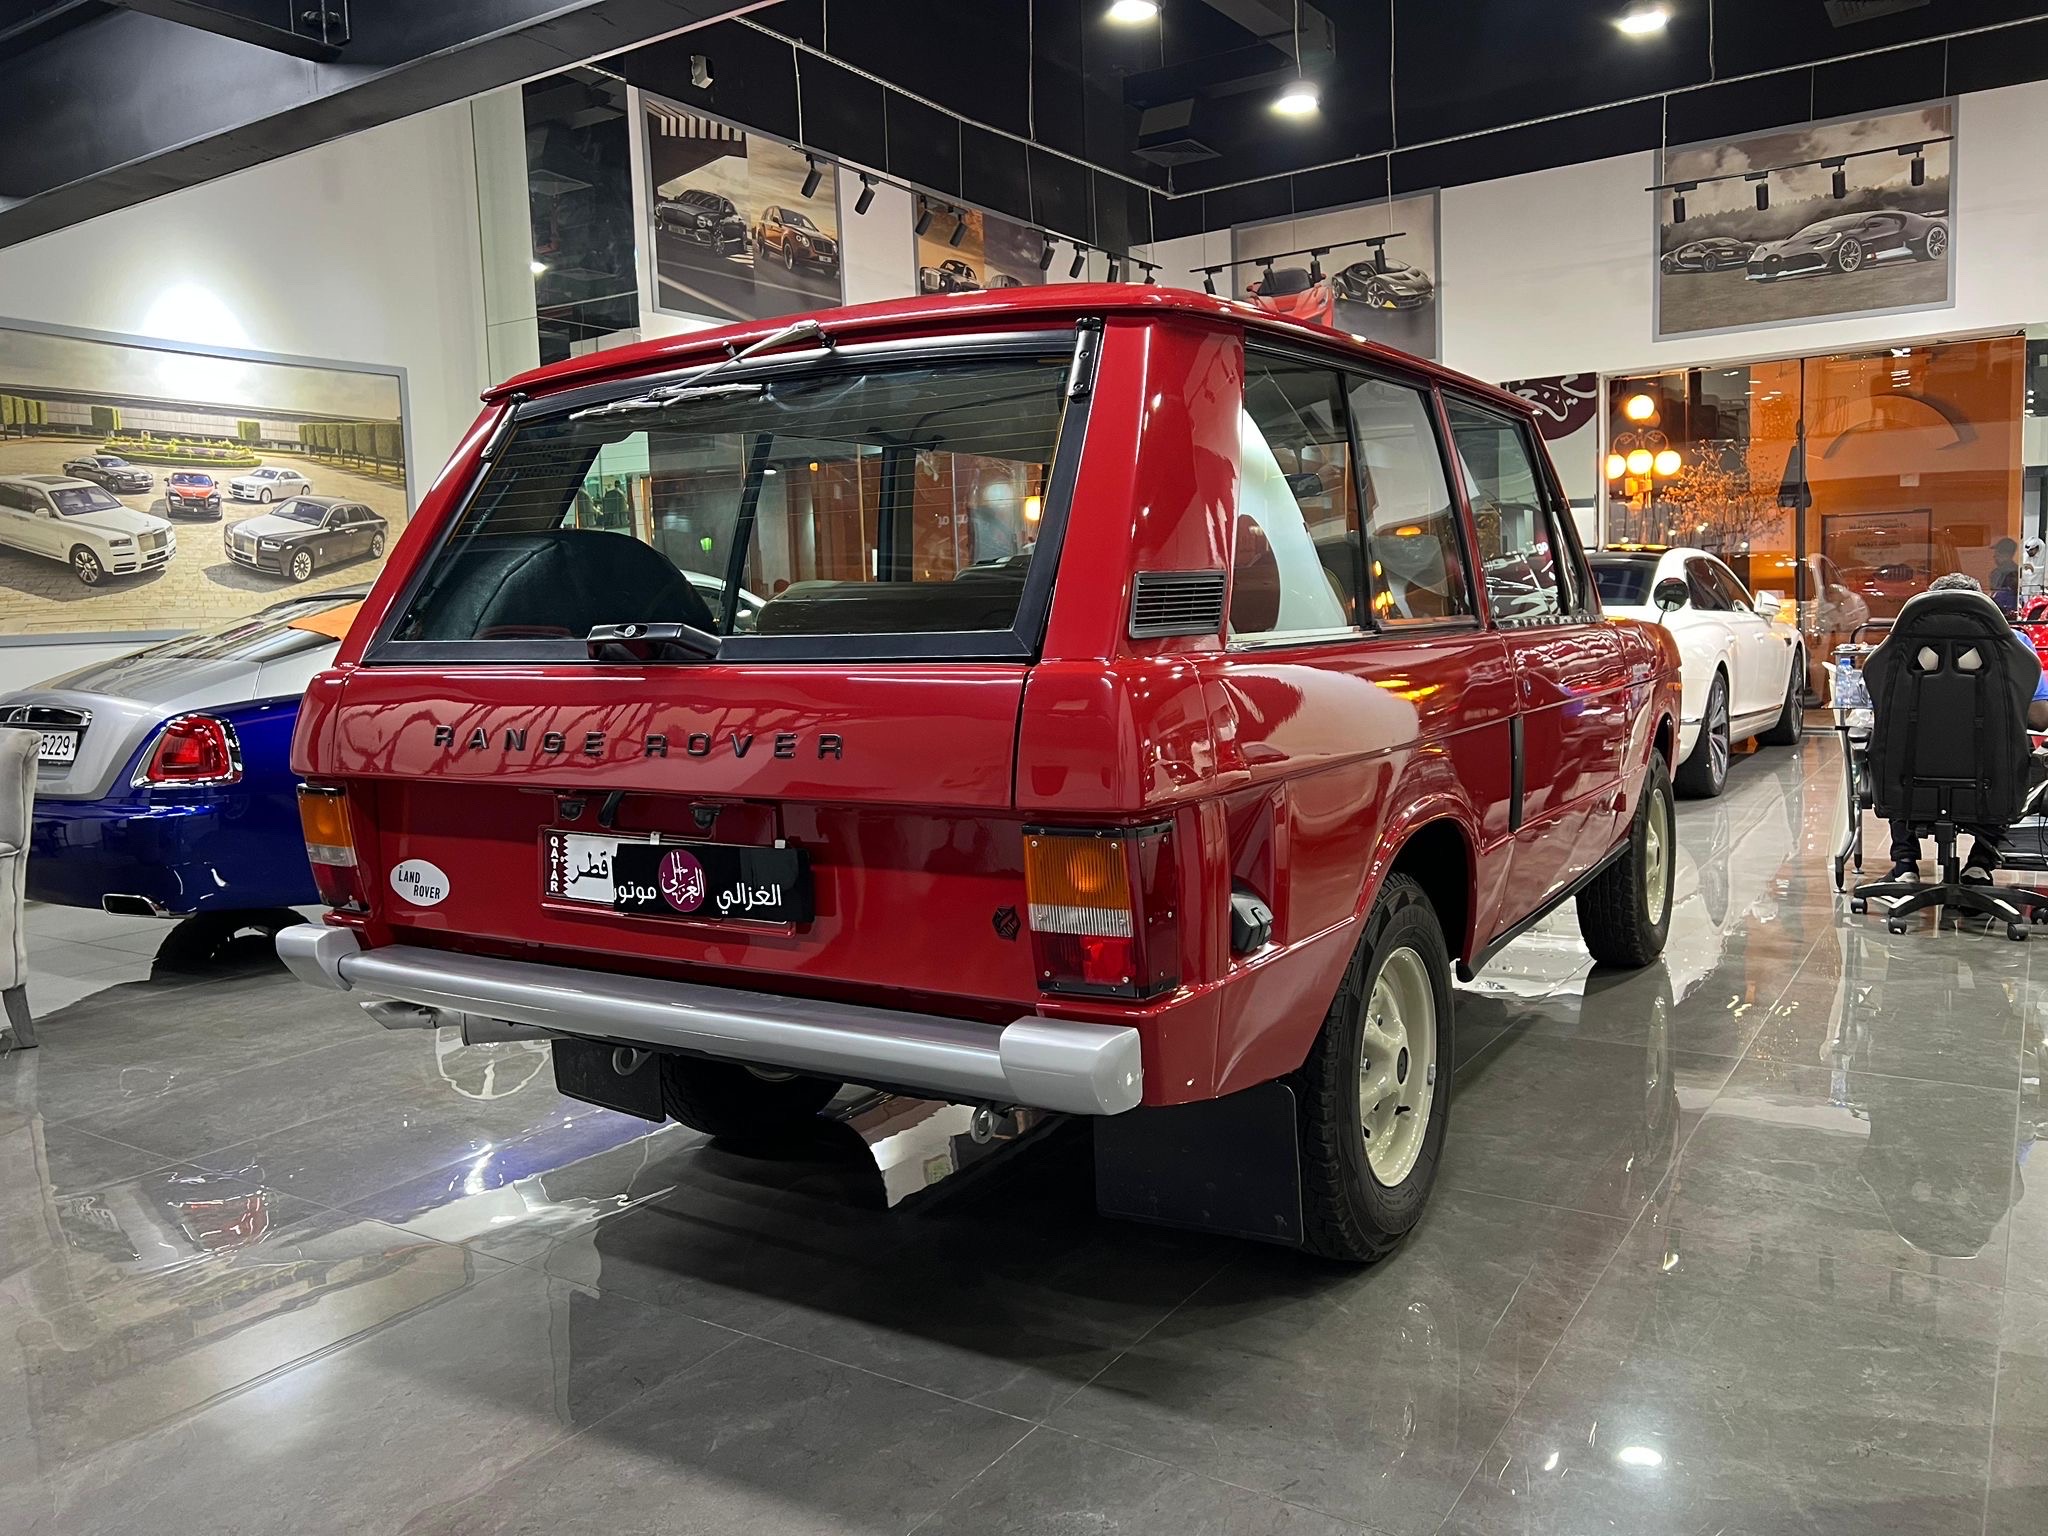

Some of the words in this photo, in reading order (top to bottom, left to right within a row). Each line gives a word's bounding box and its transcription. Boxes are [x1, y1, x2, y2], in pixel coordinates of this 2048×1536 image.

[41, 734, 71, 756] 5229
[434, 724, 606, 757] RANGE
[644, 732, 844, 759] ROVER
[398, 869, 421, 884] LAND
[550, 836, 560, 892] QATAR
[567, 850, 609, 885] قطر
[413, 884, 441, 900] ROVER
[716, 881, 782, 915] الغزالي
